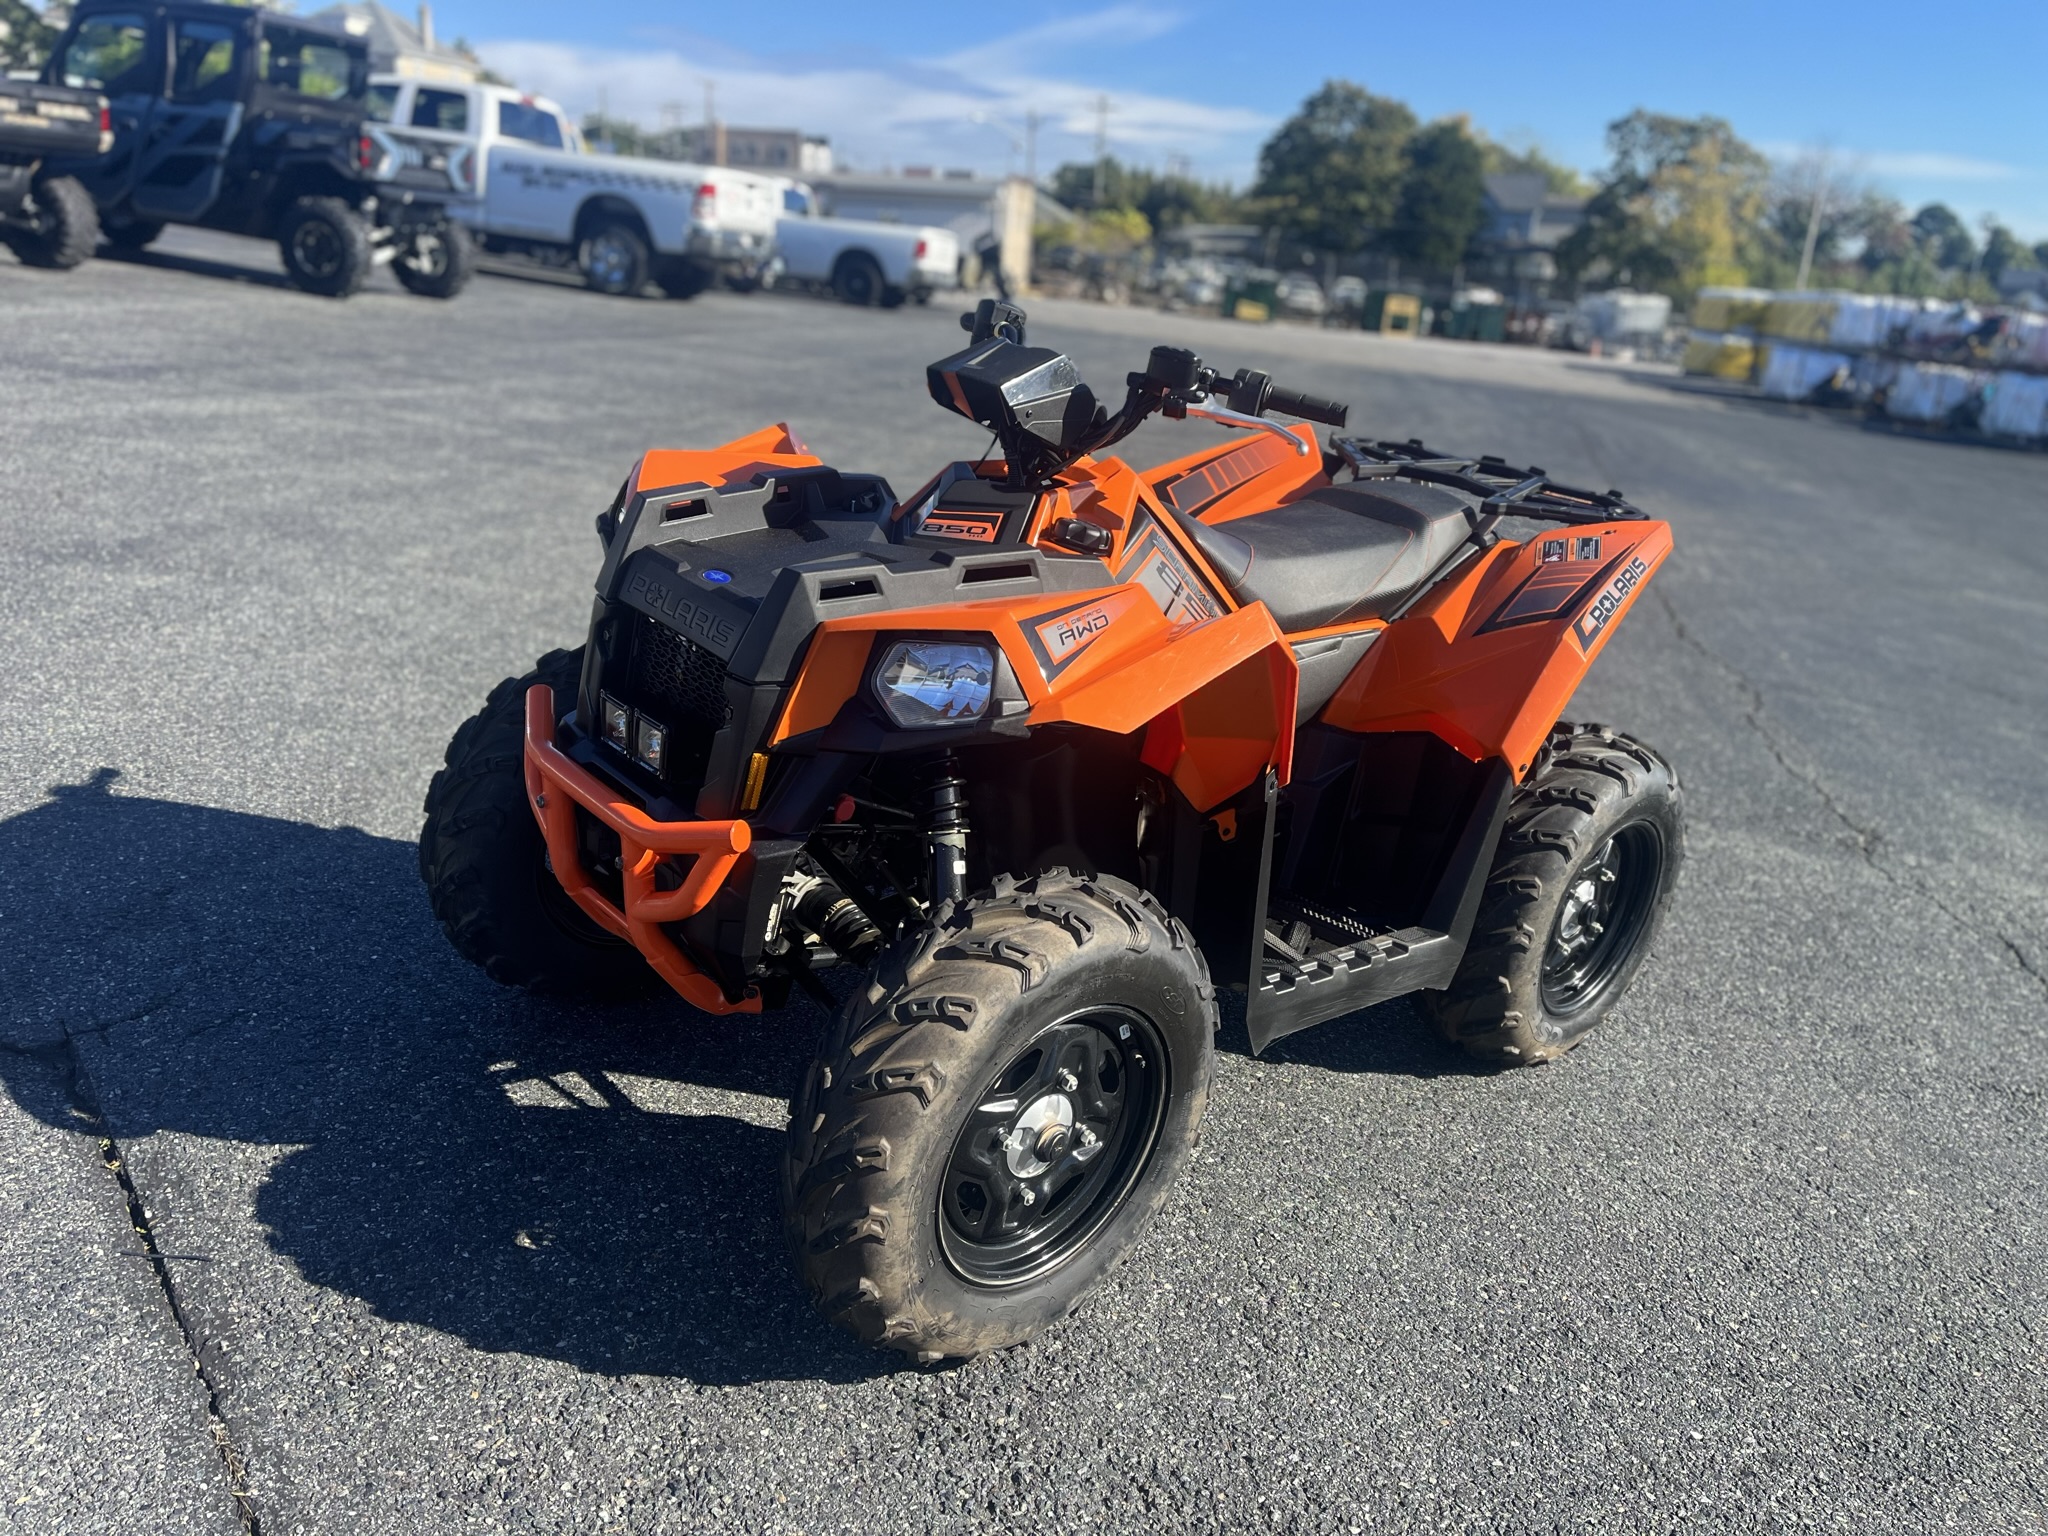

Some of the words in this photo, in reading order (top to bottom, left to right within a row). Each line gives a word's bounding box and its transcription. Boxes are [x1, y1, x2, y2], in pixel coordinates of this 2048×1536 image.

[921, 523, 989, 535] 850
[627, 571, 737, 648] POLARIS
[1589, 556, 1648, 627] POLARIS
[1058, 614, 1109, 646] AWD
